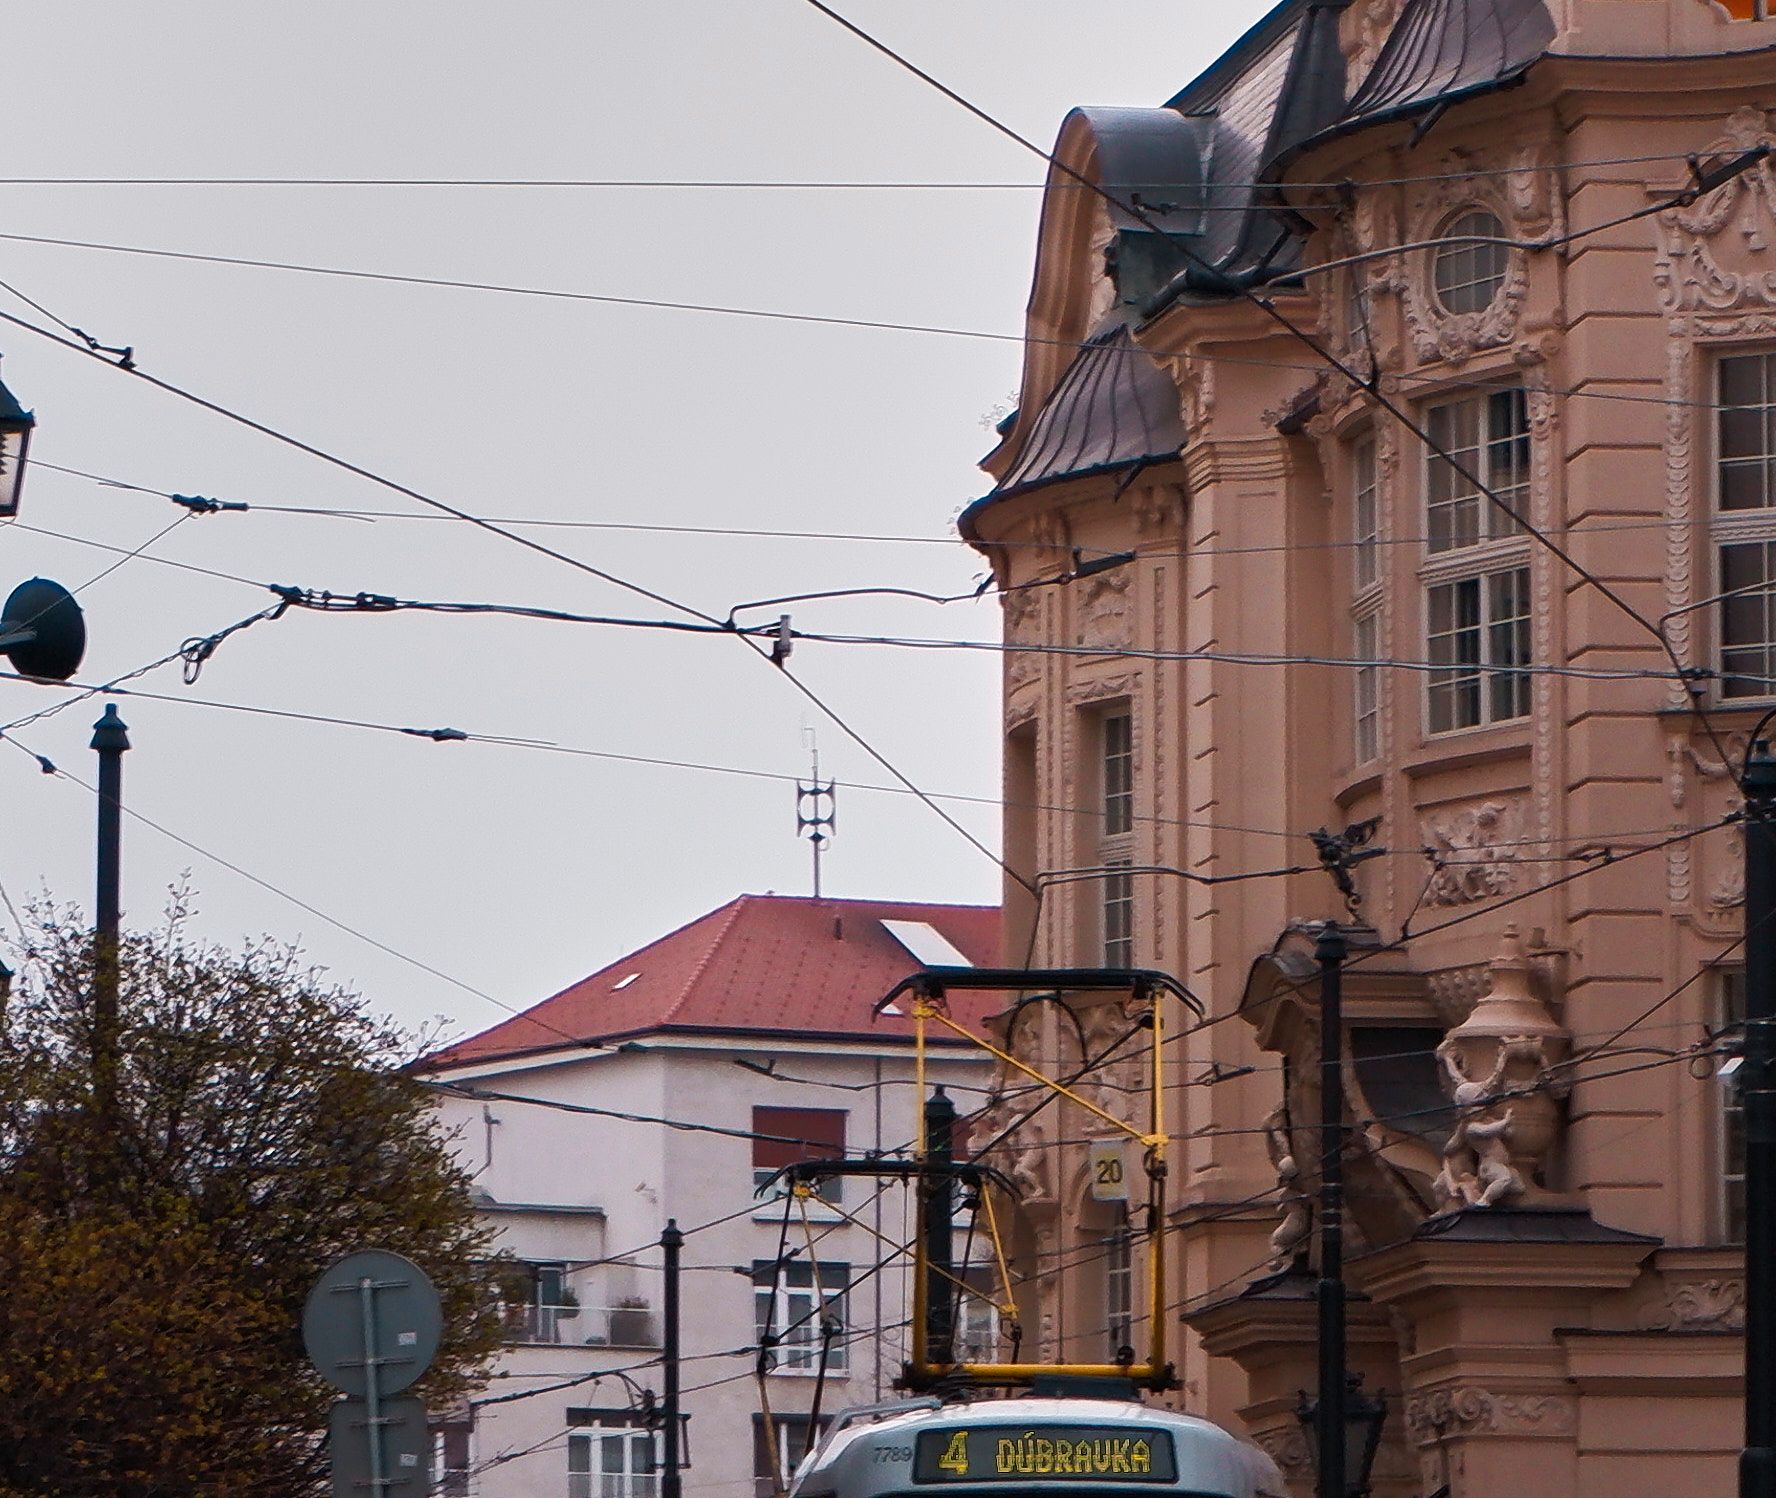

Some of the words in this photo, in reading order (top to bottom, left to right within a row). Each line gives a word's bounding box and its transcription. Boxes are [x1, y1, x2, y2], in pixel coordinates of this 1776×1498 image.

[1096, 1159, 1122, 1184] 20
[873, 1446, 913, 1463] 7789
[938, 1431, 969, 1475] 4
